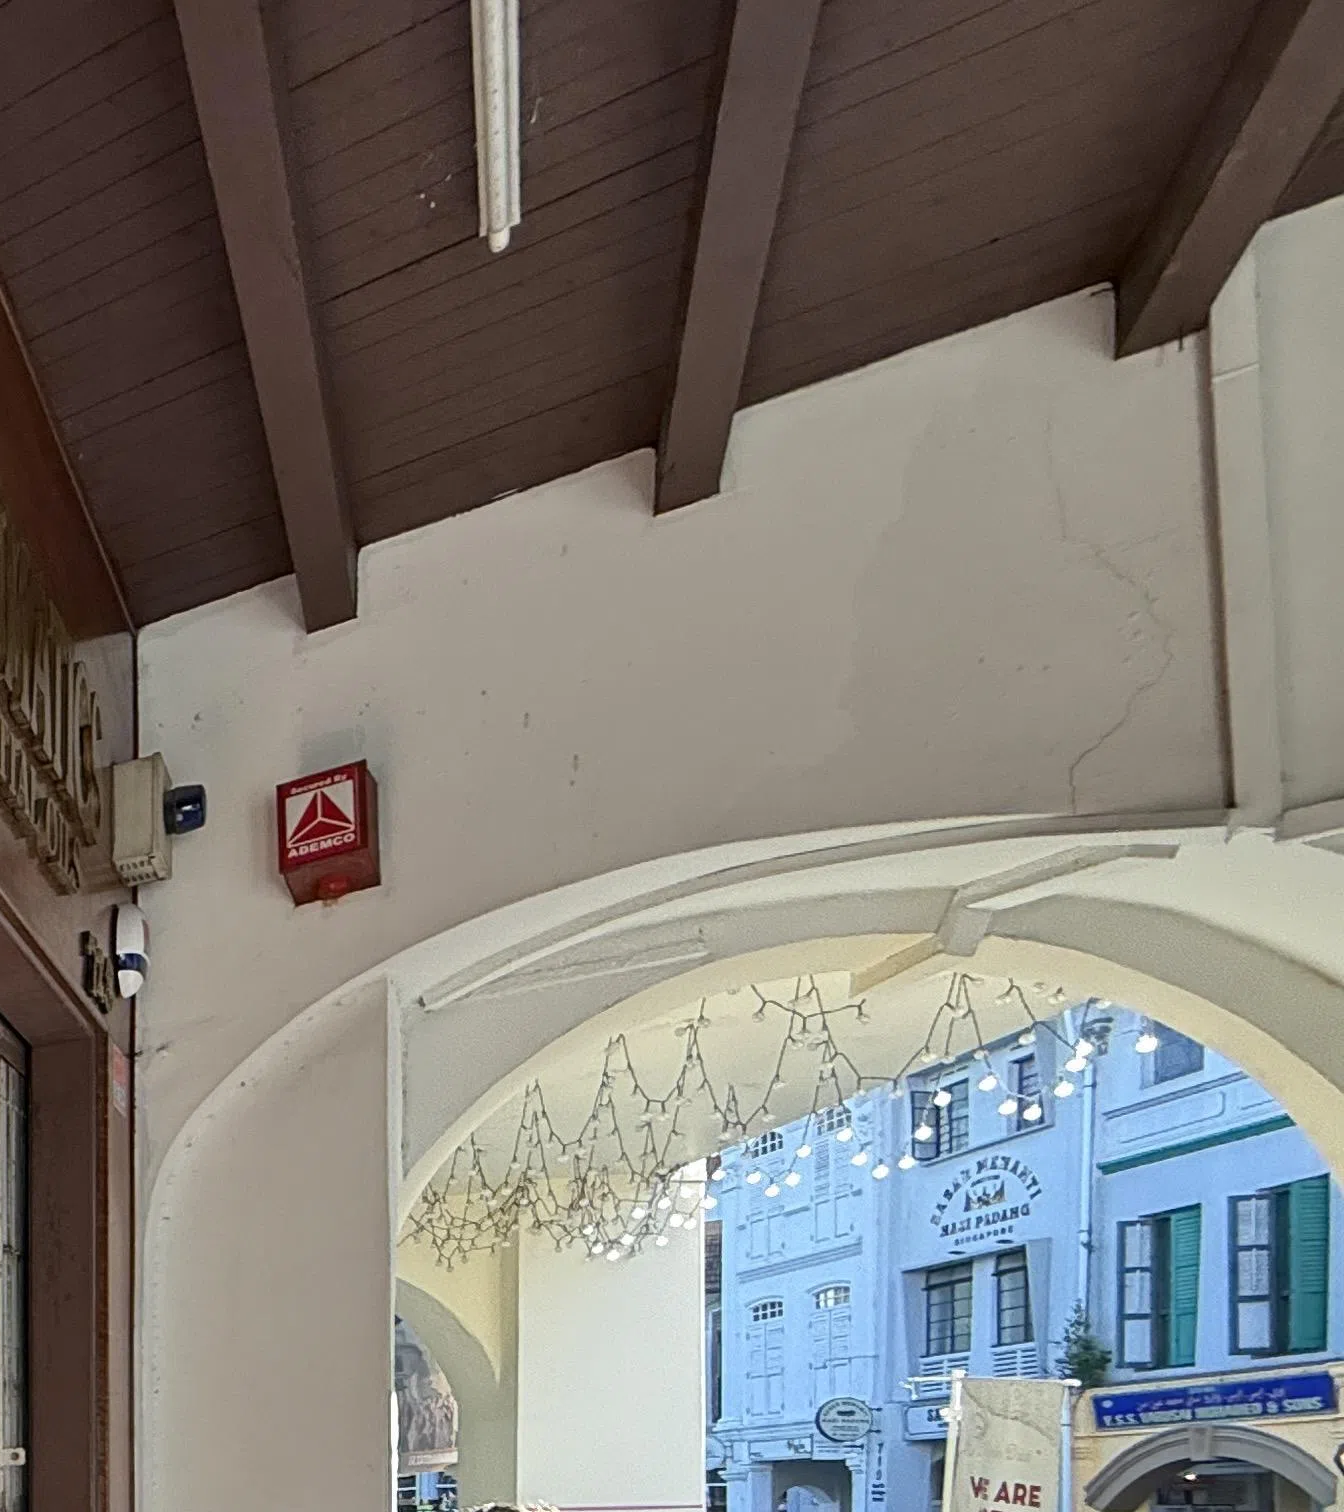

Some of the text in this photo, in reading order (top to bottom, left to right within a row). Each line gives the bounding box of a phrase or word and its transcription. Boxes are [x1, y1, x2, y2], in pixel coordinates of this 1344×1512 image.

[287, 832, 356, 859] ADEMCO
[974, 1203, 1032, 1230] PADANG
[994, 1481, 1042, 1509] ARE
